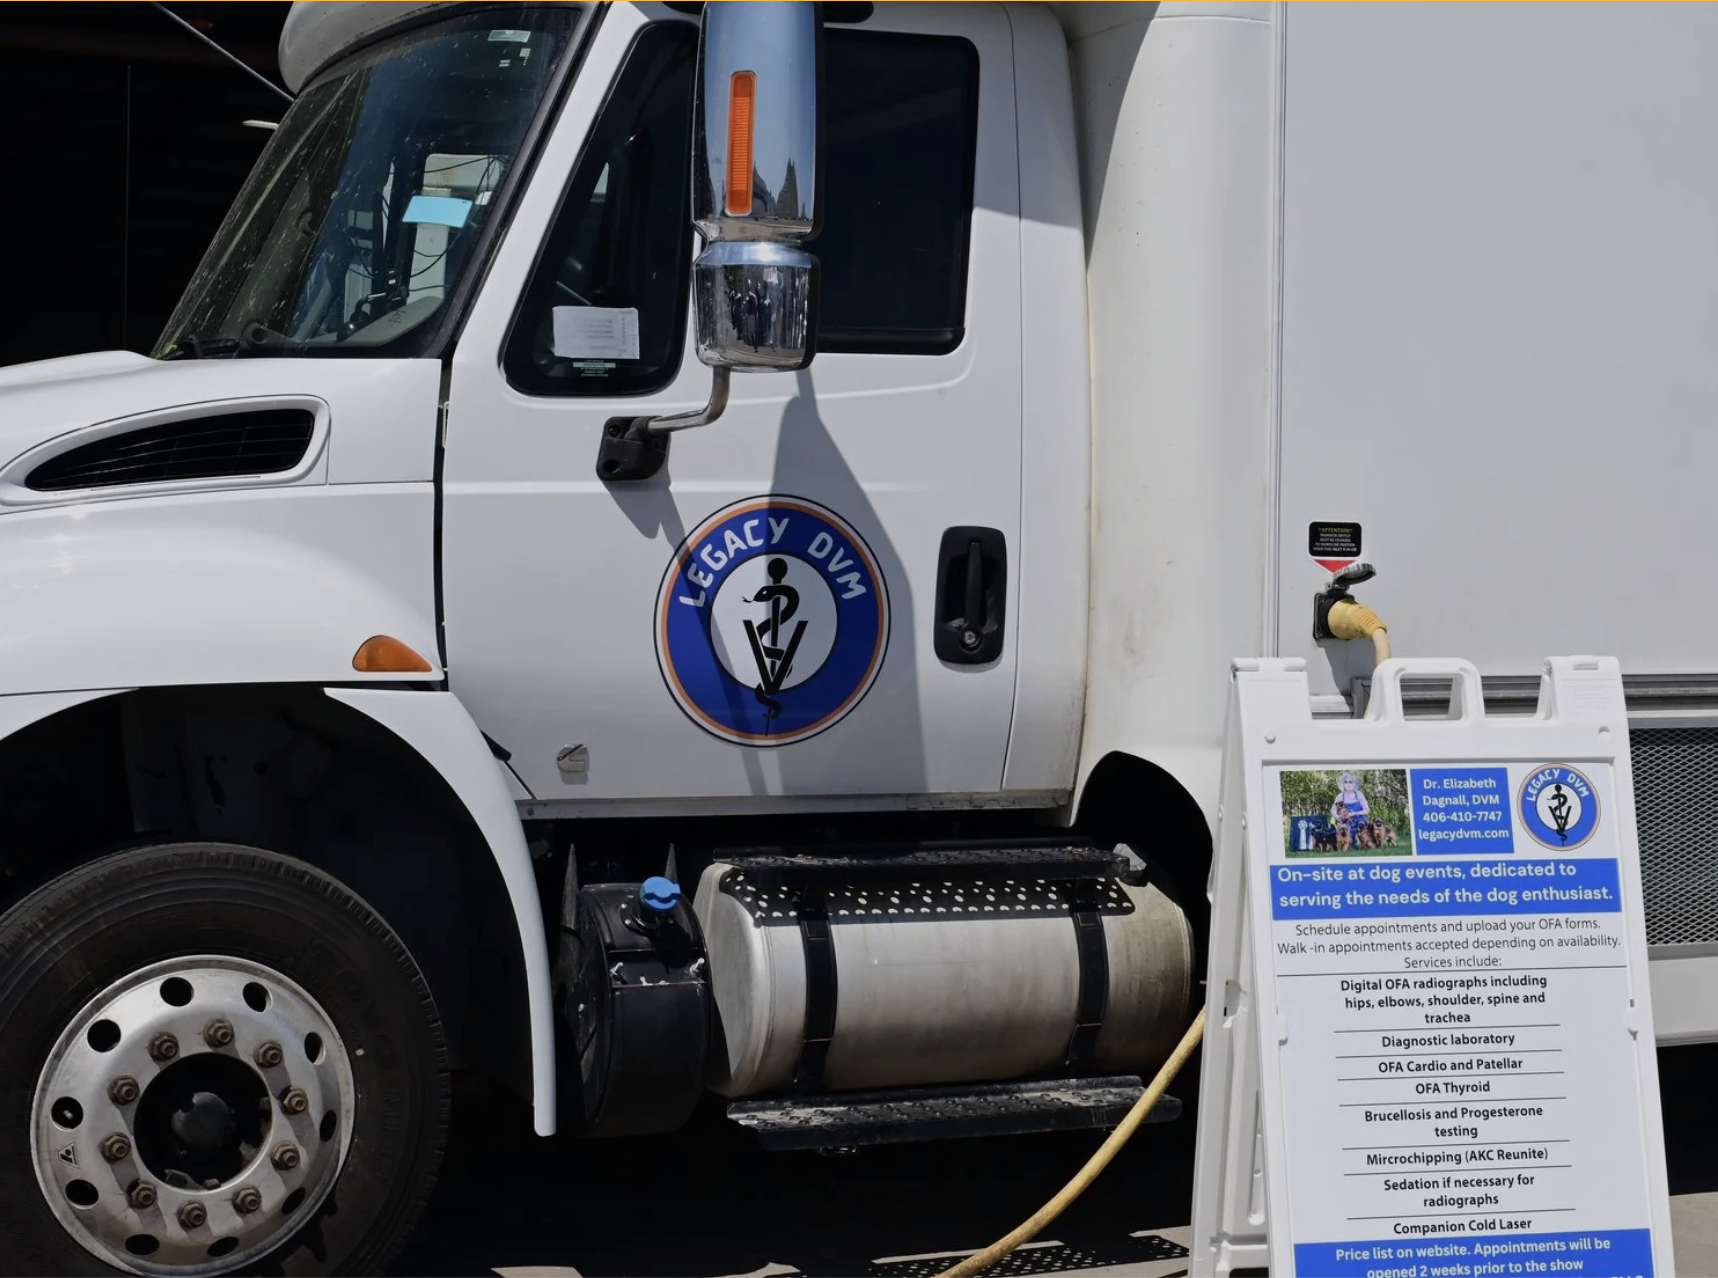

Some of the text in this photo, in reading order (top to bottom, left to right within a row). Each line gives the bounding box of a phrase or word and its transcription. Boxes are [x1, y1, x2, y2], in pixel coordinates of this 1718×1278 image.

[679, 517, 867, 607] LEGACY DVM
[1424, 778, 1496, 789] Dr. Elizabeth
[1526, 769, 1589, 801] LEGACY DVM
[1423, 795, 1499, 808] Dagnall, DVM
[1423, 811, 1502, 822] 406-410-7747
[1418, 828, 1510, 842] legacydvm.com
[1278, 862, 1576, 883] On-site at dog events, dedicated to
[1280, 886, 1612, 909] serving the needs of the dog enthusiast.
[1296, 918, 1600, 936] Schedule appointments and upload your OFA forms.
[1329, 941, 1412, 955] appointments
[1416, 938, 1468, 952] accepted
[1472, 937, 1535, 951] depending
[1539, 939, 1554, 947] on
[1557, 935, 1620, 948] availability.
[1404, 955, 1501, 968] Services include:
[1341, 975, 1547, 993] Digital OFA radiographs including
[1345, 992, 1545, 1011] hips, elbows, shoulder, spine and
[1425, 1012, 1470, 1023] trachea
[1382, 1034, 1514, 1049] Diagnostic laboratory
[1379, 1058, 1522, 1072] OFA Cardio and Patellar
[1416, 1081, 1490, 1095] OFA Thyroid
[1365, 1107, 1542, 1121] Brucellosis and Progesterone
[1435, 1125, 1477, 1138] testing
[1367, 1148, 1547, 1165] Mircrochipping (AKC Reunite)
[1384, 1174, 1534, 1190] Sedation if necessary for
[1424, 1194, 1498, 1208] radiographs
[1394, 1219, 1531, 1235] Companion Cold Laser
[1336, 1238, 1610, 1260] Price list on website. Appointments will be
[1367, 1259, 1583, 1278] opened 2 weeks prior to the show
